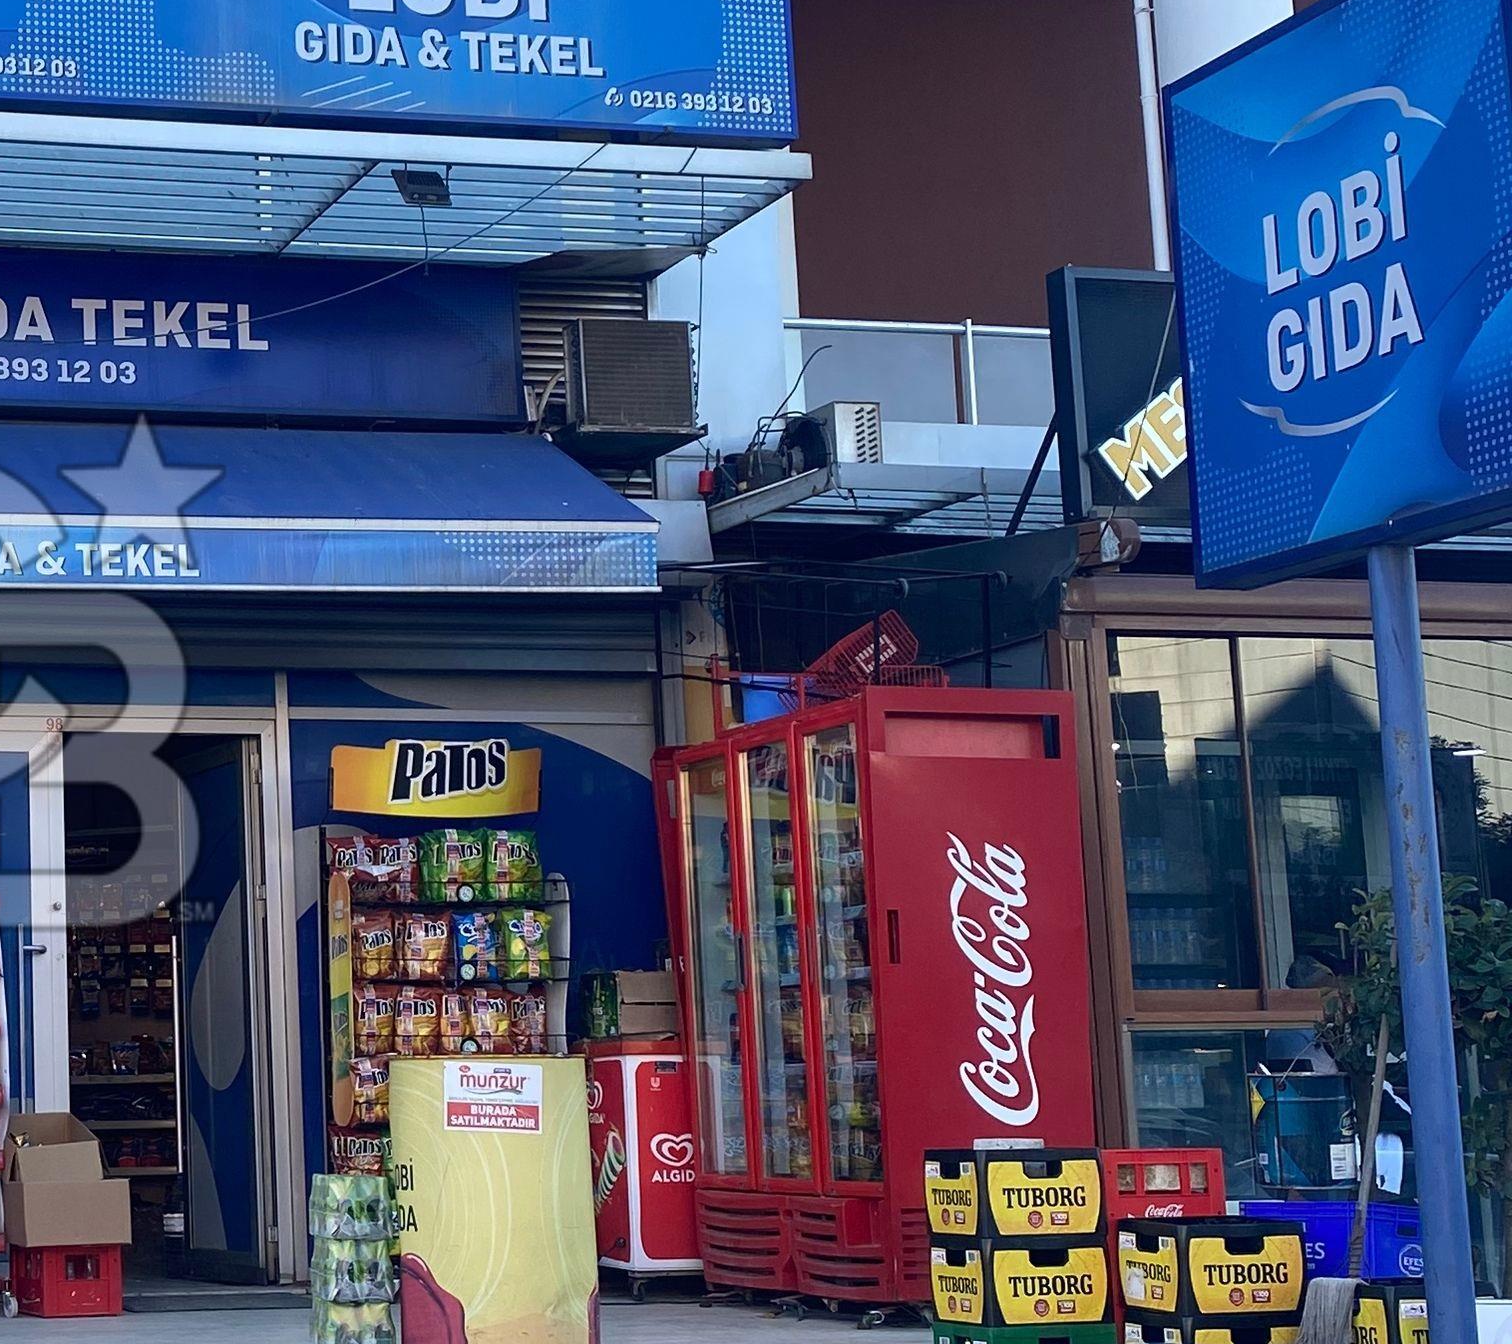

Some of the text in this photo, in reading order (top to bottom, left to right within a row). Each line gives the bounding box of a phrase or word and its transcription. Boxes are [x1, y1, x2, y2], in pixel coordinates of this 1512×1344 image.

[294, 21, 607, 79] GIDA & TEKEL
[50, 58, 78, 78] 03
[630, 90, 677, 110] 0216
[748, 96, 775, 115] 03
[71, 298, 269, 351] TEKEL
[1266, 262, 1424, 393] GIDA
[57, 359, 91, 383] 12
[99, 360, 137, 384] 03
[36, 540, 67, 576] &
[75, 542, 201, 577] TEKEL
[46, 716, 64, 731] 98
[460, 1074, 526, 1090] munzur
[451, 1115, 536, 1129] SATILMAKTADIR
[470, 1105, 517, 1117] BURADA
[931, 1188, 972, 1207] TUBORG
[1003, 1186, 1086, 1208] TUBORG
[1203, 1262, 1288, 1286] TUBORG
[938, 1275, 978, 1296] TUBORG
[1008, 1274, 1093, 1297] TUBORG
